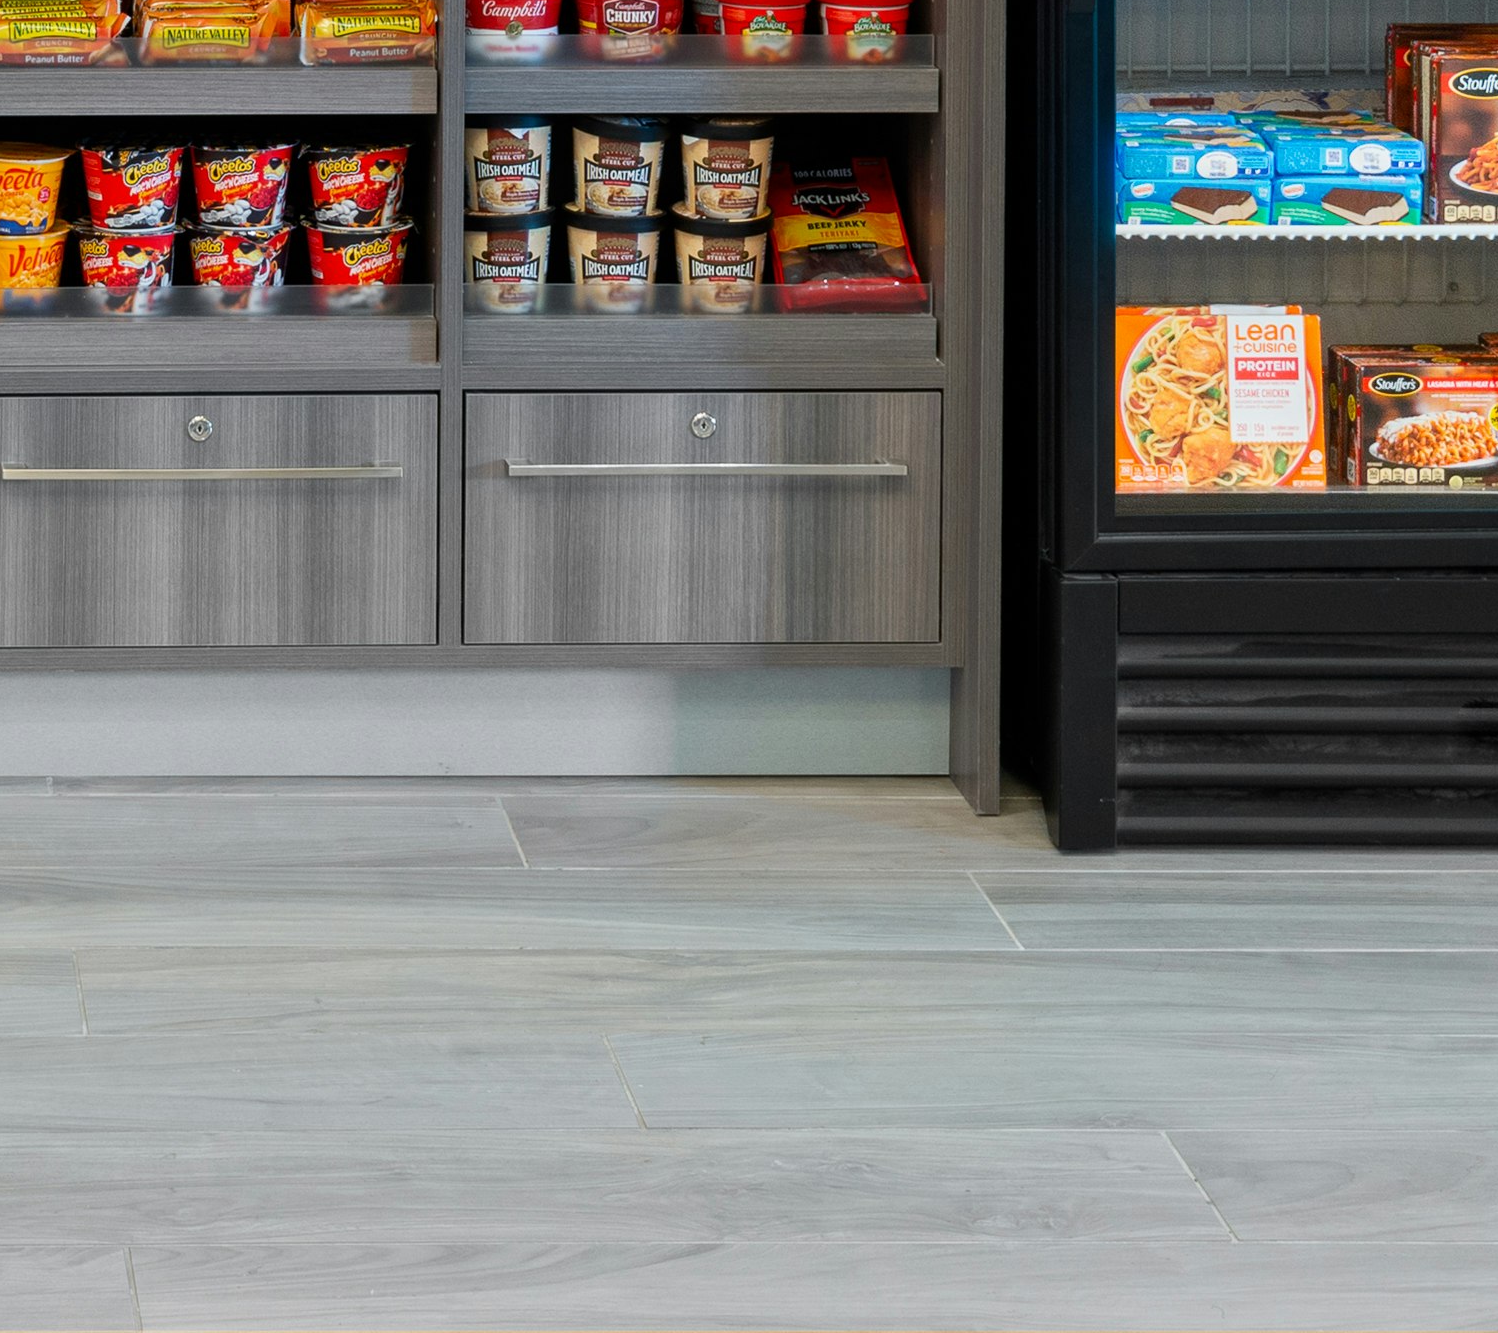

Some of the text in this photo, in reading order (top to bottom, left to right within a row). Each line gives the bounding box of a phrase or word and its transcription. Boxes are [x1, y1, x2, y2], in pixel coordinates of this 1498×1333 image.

[605, 8, 655, 25] CHUNKY
[11, 21, 94, 40] NATURE VALLEY
[477, 163, 540, 178] IRISH OATMEAL
[587, 168, 649, 183] IRISH OATMEAL
[1235, 323, 1296, 341] Lean
[1237, 361, 1296, 372] PROTEIN
[1375, 375, 1418, 394] Stouffer's
[1234, 389, 1290, 397] SESAME CHICKEN
